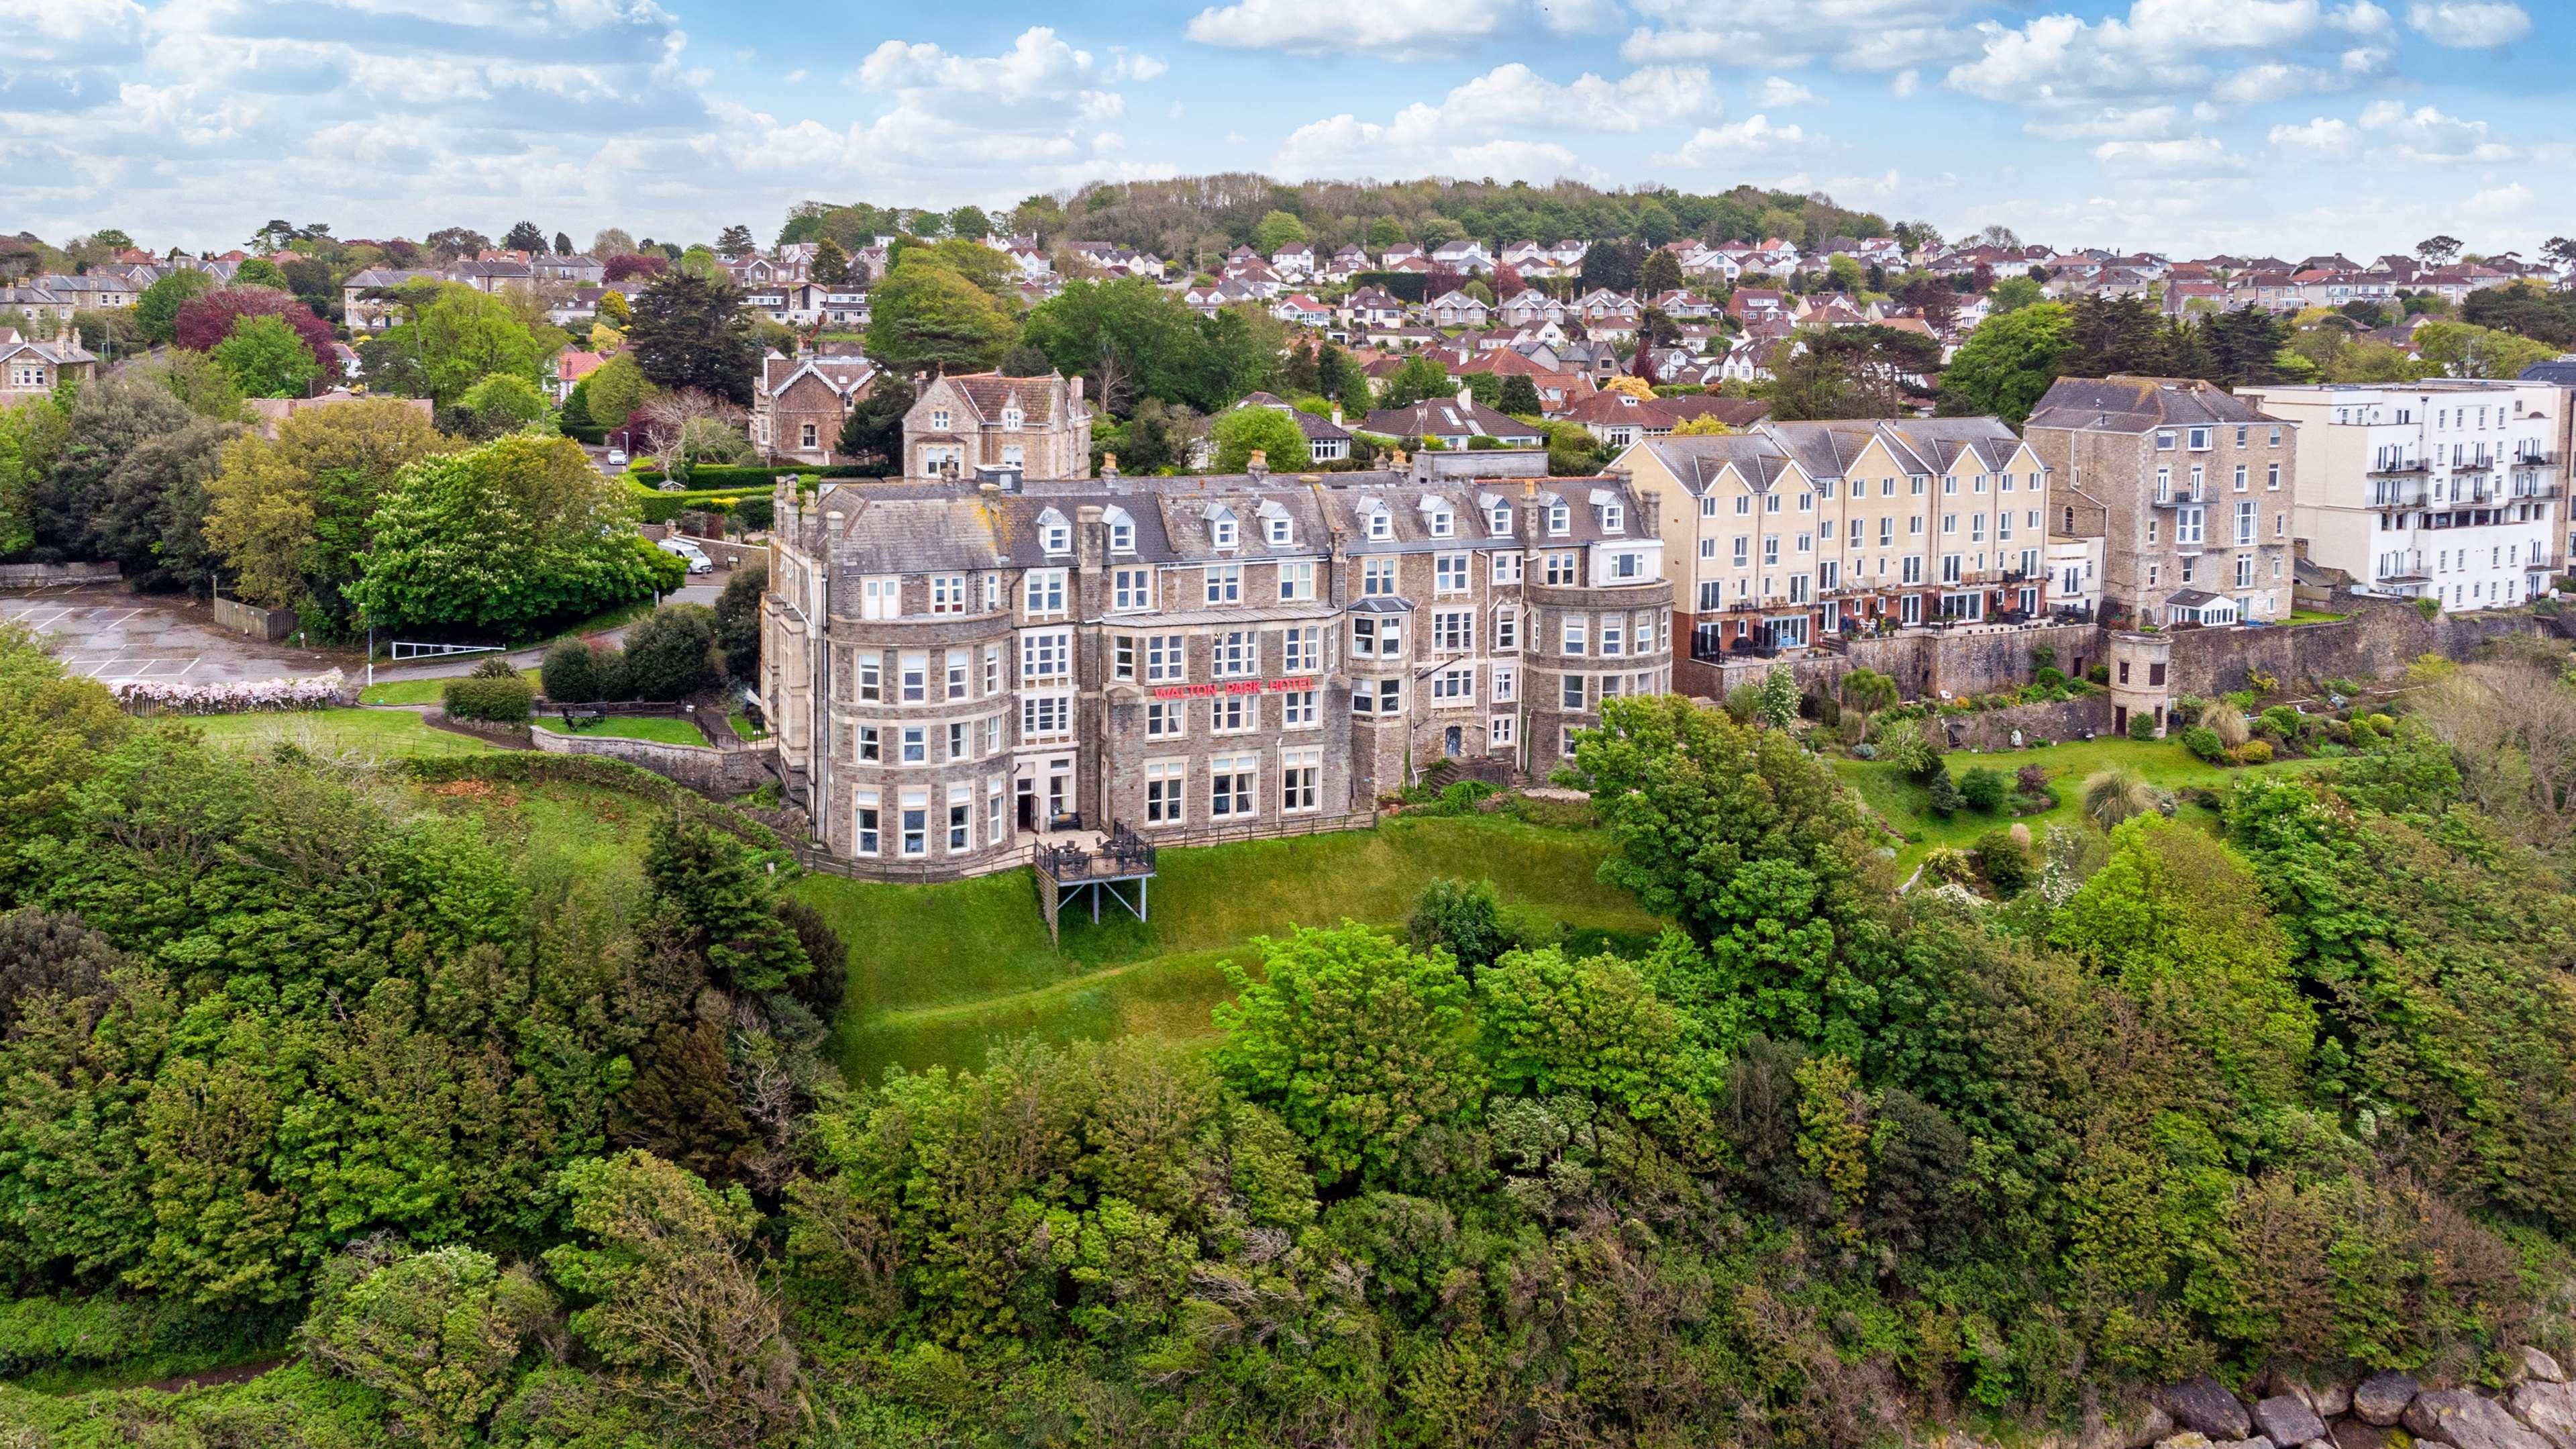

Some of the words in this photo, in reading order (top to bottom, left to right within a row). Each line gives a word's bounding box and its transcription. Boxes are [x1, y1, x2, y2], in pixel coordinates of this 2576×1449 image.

[1154, 683, 1217, 699] WALTON
[1225, 681, 1262, 695] PARK
[1268, 677, 1314, 692] HOTEL
